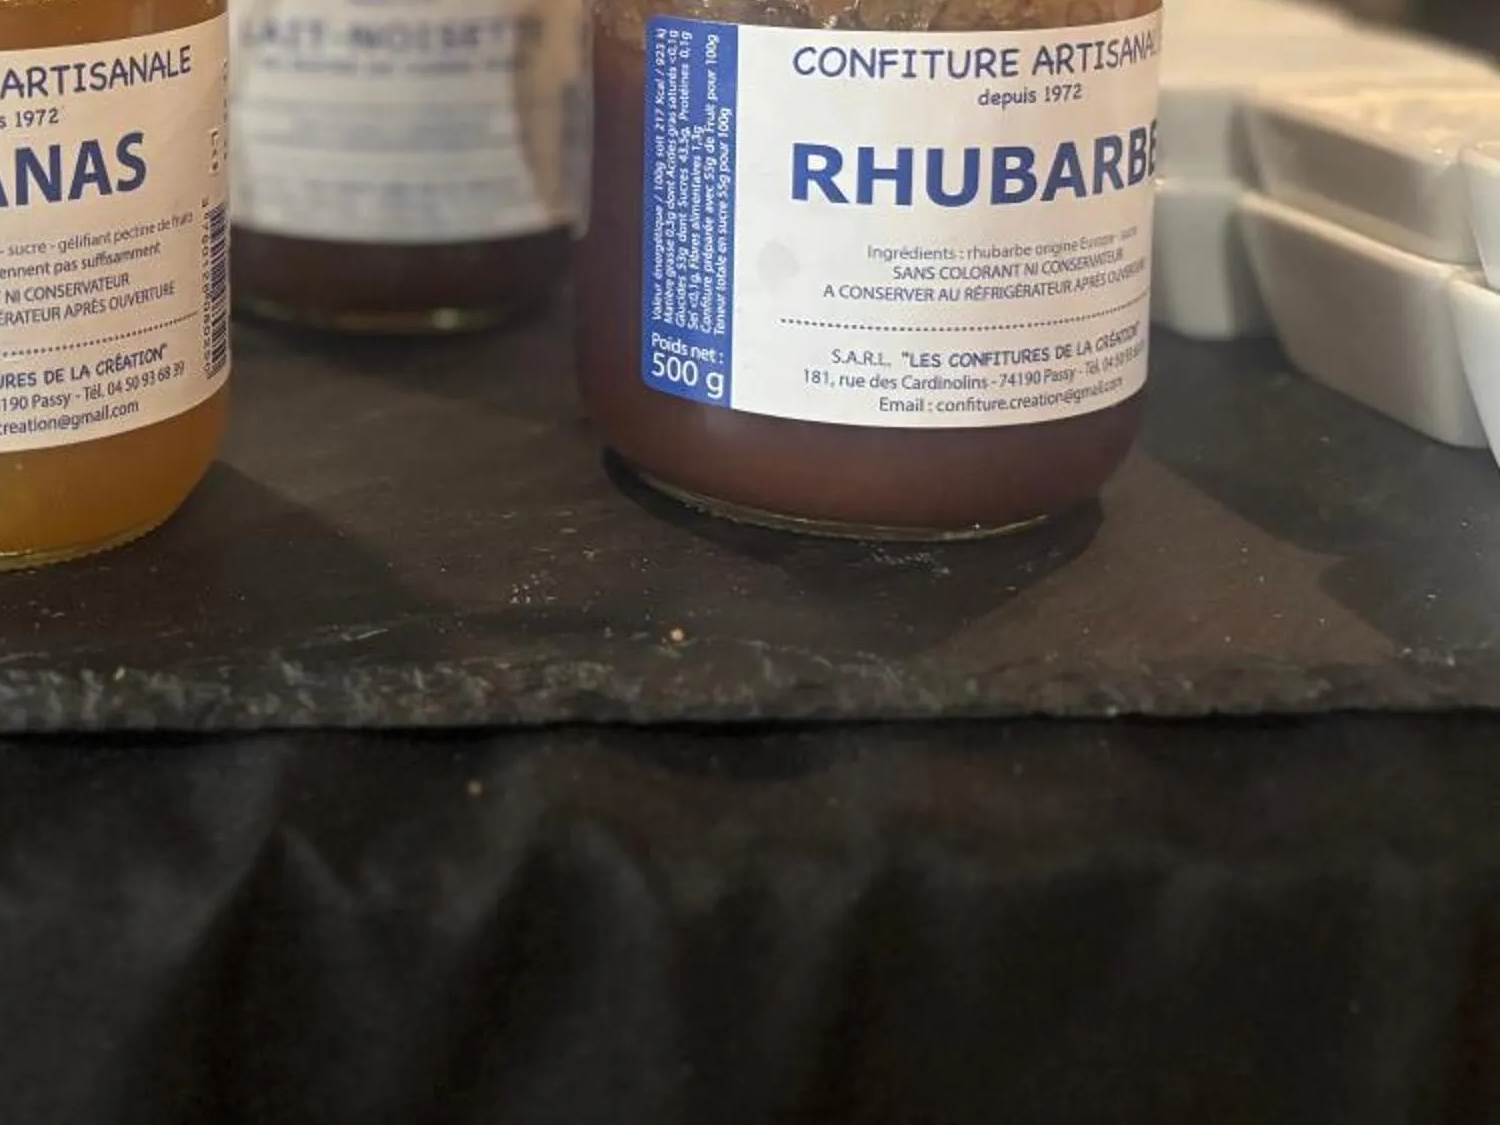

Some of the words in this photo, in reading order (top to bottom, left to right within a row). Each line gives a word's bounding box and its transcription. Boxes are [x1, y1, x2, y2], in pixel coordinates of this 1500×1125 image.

[705, 34, 719, 65] 100g
[792, 46, 1019, 80] CONFITURE
[0, 45, 192, 99] ARTISANALE
[978, 88, 1037, 110] depuis
[1043, 83, 1083, 102] 1972
[15, 108, 60, 128] 1972
[9, 241, 46, 256] sucre
[867, 245, 956, 262] Ingrédients
[967, 243, 1031, 258] rhubarbe
[53, 260, 77, 276] pas
[892, 266, 935, 280] SANS
[939, 264, 1019, 280] COLORANT
[1024, 262, 1039, 276] NI
[5, 290, 20, 304] NI
[24, 273, 130, 301] CONSERVATEUR
[64, 297, 106, 315] APRÈS
[109, 280, 175, 310] OUVERTURE
[824, 284, 835, 297] A
[838, 285, 933, 301] CONSERVER
[938, 287, 960, 301] AU
[964, 280, 1072, 301] RÉFRIGÉRATEUR
[652, 332, 688, 356] Poids
[691, 346, 717, 363] net
[901, 351, 941, 368] "LES
[948, 347, 1049, 368] CONFITURES
[1055, 343, 1072, 359] DE
[1076, 339, 1092, 356] LA
[43, 368, 64, 385] DE
[70, 364, 90, 380] LA
[95, 343, 168, 376] CRÉATION"
[651, 351, 699, 386] 500
[705, 371, 724, 399] g
[31, 393, 72, 409] Passy
[83, 383, 105, 401] Tél.
[107, 380, 122, 396] 04
[125, 376, 140, 392] 50
[141, 370, 155, 387] 93
[803, 368, 834, 388] 181,
[840, 375, 865, 388] rue
[870, 375, 896, 389] des
[901, 374, 988, 390] Cardinolins
[1001, 370, 1041, 387] 74190
[879, 396, 924, 412] Email
